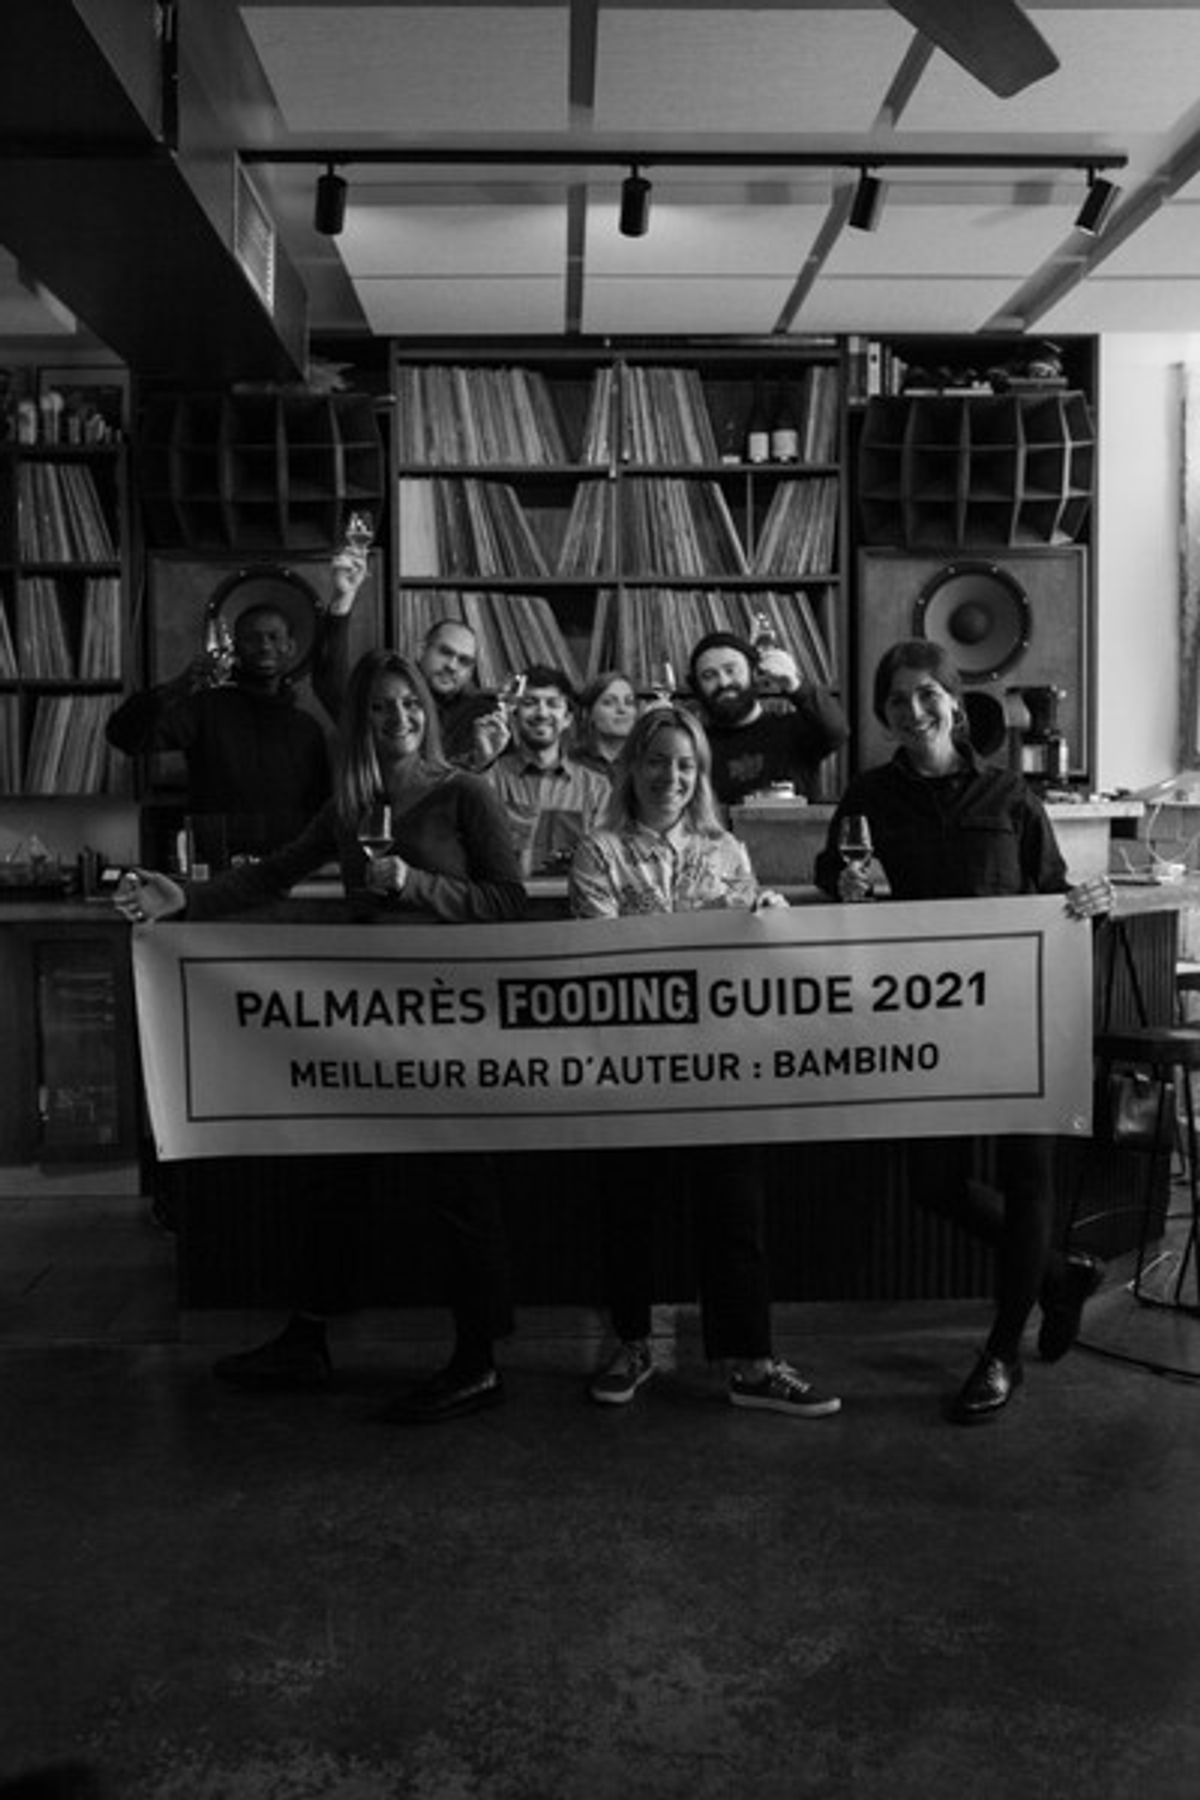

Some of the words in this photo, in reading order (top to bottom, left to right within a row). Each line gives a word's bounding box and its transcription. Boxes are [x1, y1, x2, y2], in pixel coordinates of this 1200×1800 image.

[235, 977, 486, 1028] PALMARÈS
[710, 978, 853, 1017] GUIDE
[873, 972, 986, 1012] 2021
[290, 1059, 466, 1089] MEILLEUR
[478, 1058, 550, 1089] BAR
[562, 1052, 740, 1087] D'AUTEUR
[773, 1042, 939, 1079] BAMBINO
